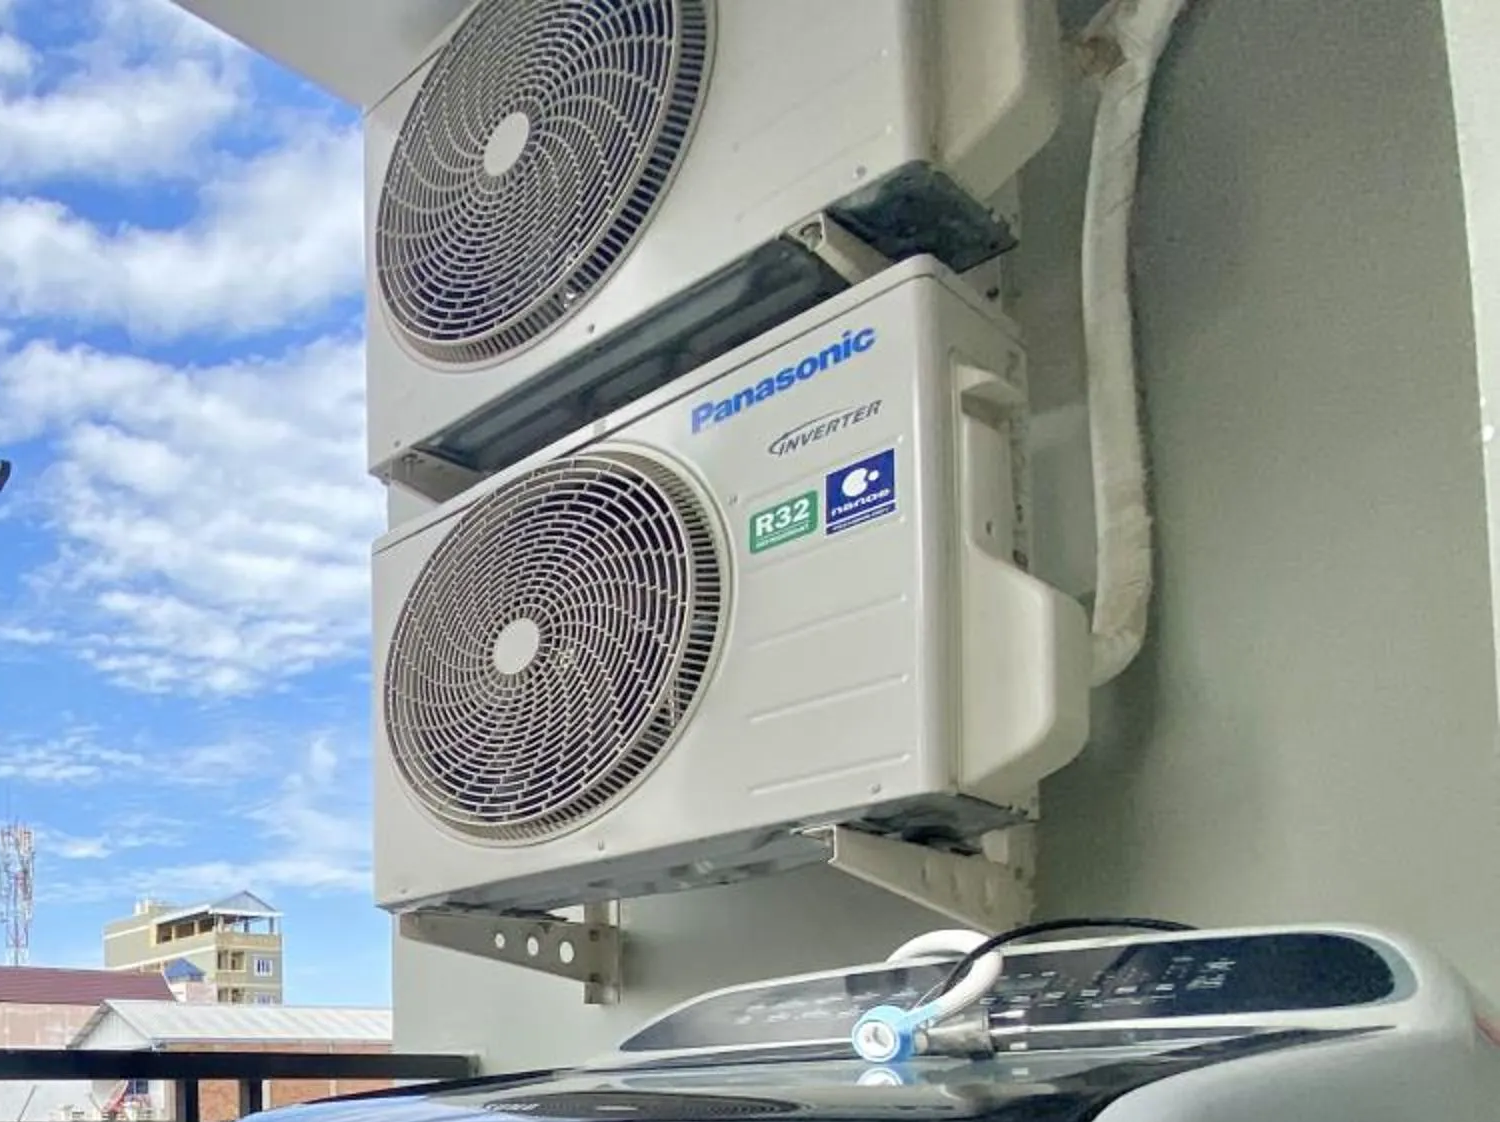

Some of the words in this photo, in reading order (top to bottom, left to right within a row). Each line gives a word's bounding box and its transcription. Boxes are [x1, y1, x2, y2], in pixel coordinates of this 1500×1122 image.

[691, 327, 876, 435] Panasonic
[778, 400, 882, 457] INVERTER
[755, 498, 810, 537] R32
